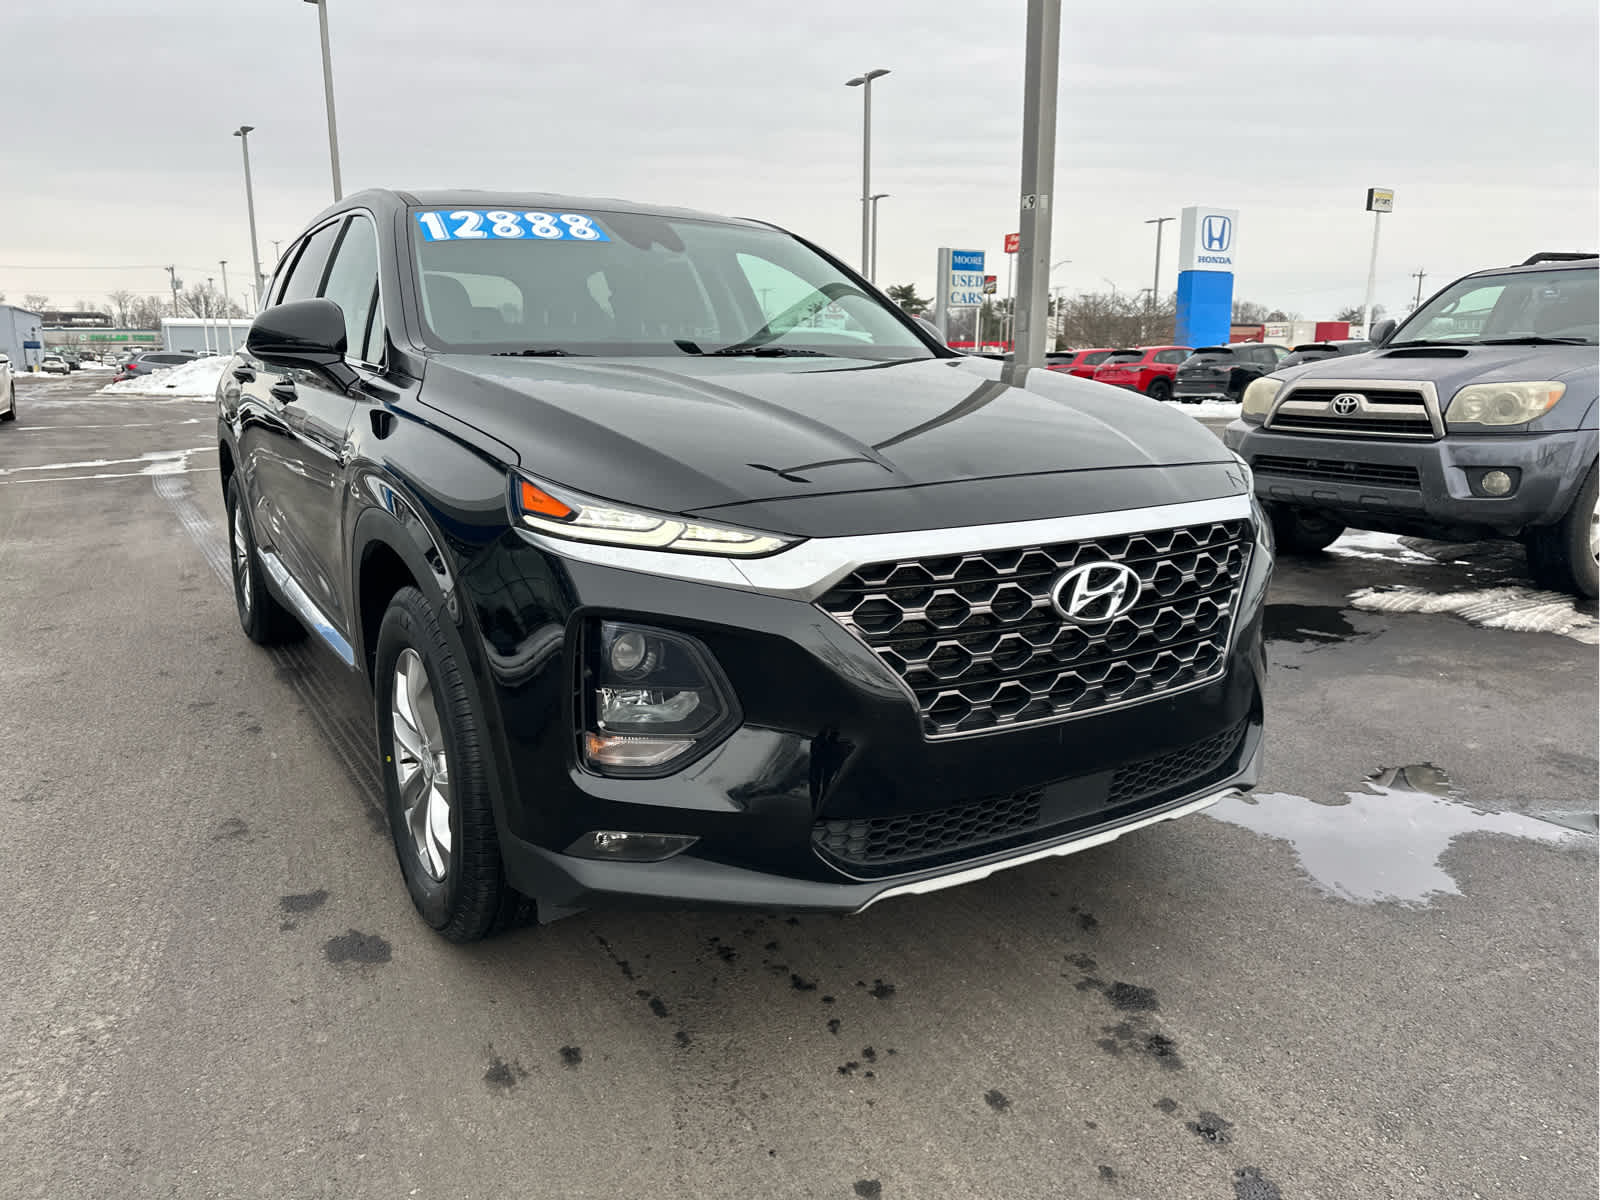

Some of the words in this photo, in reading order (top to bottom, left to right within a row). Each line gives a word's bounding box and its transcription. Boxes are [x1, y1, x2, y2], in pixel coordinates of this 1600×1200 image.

[420, 210, 600, 240] 12888
[953, 255, 983, 265] MOORE
[1198, 256, 1232, 264] HONDA
[952, 274, 984, 288] USED
[951, 291, 983, 304] CARS
